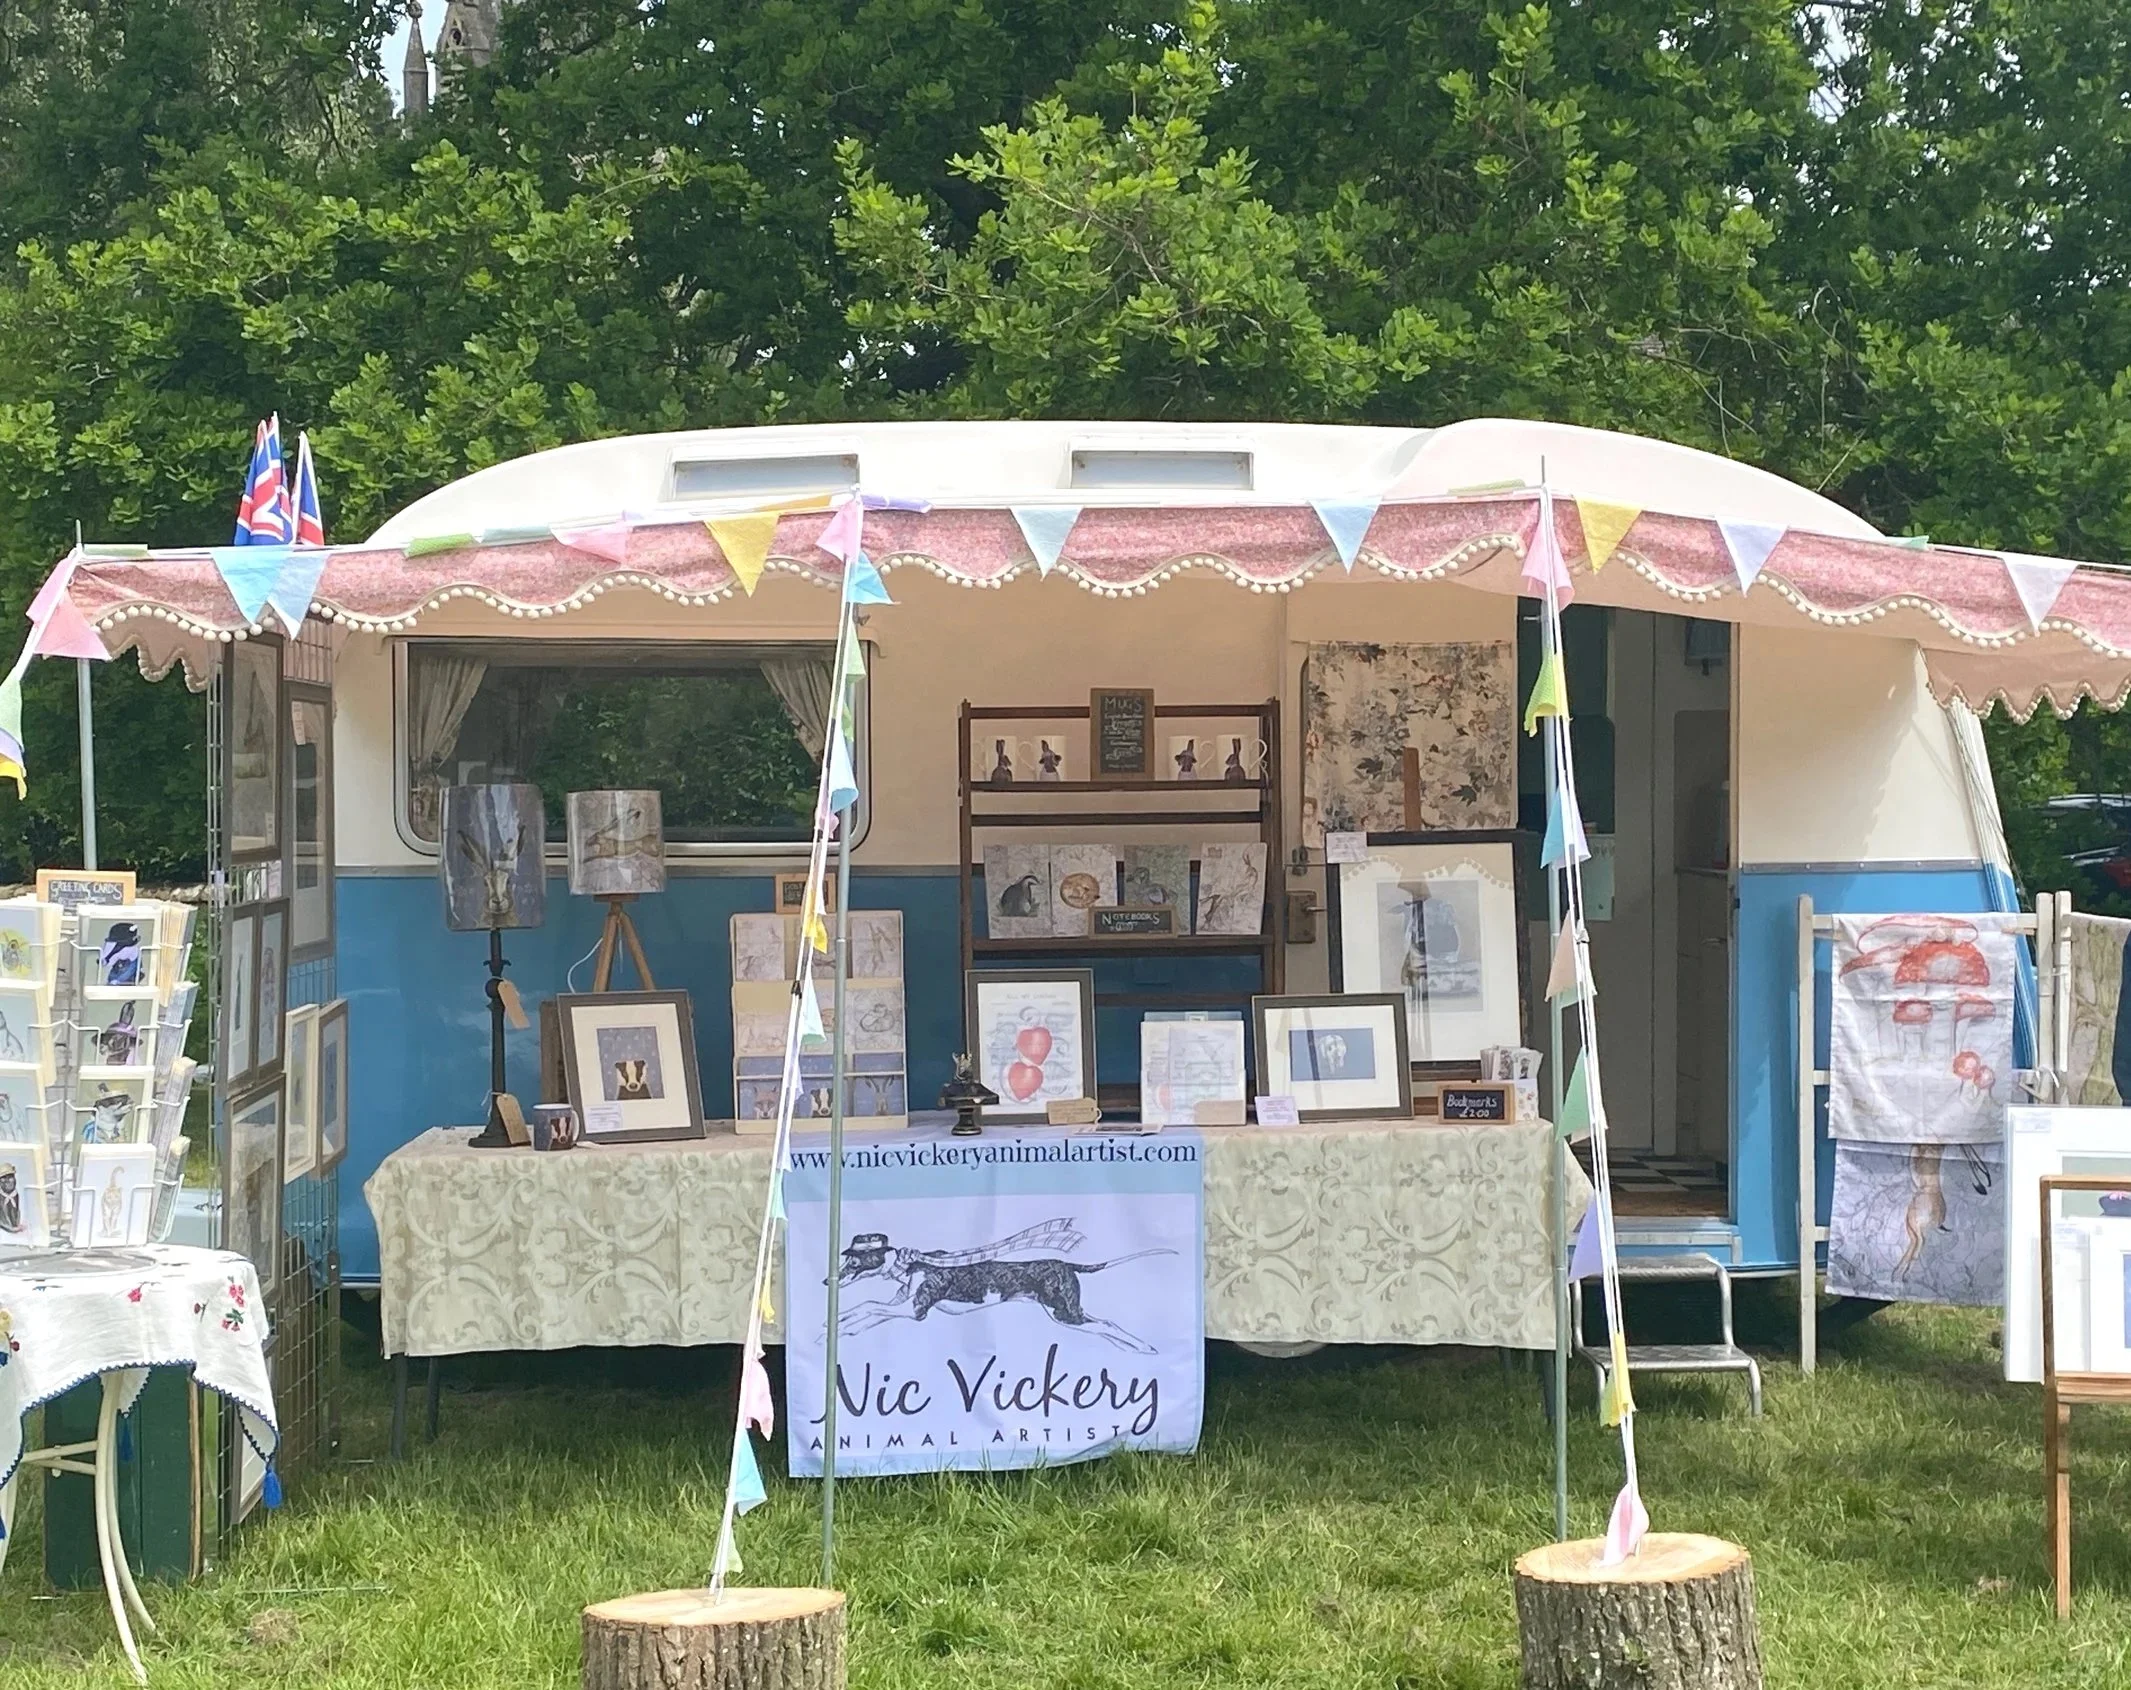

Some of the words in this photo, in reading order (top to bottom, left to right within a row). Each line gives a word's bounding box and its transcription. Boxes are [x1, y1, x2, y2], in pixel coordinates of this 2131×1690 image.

[1104, 696, 1143, 713] MUGS
[50, 881, 92, 899] GREETING
[93, 883, 123, 900] CARDS
[1102, 912, 1160, 925] NOTEBOOKS
[1446, 1093, 1498, 1108] Bookmarks
[810, 1362, 932, 1424] Nic
[946, 1342, 1158, 1436] Vickery
[810, 1430, 958, 1450] ANIMAL
[991, 1425, 1121, 1443] ARTIST
